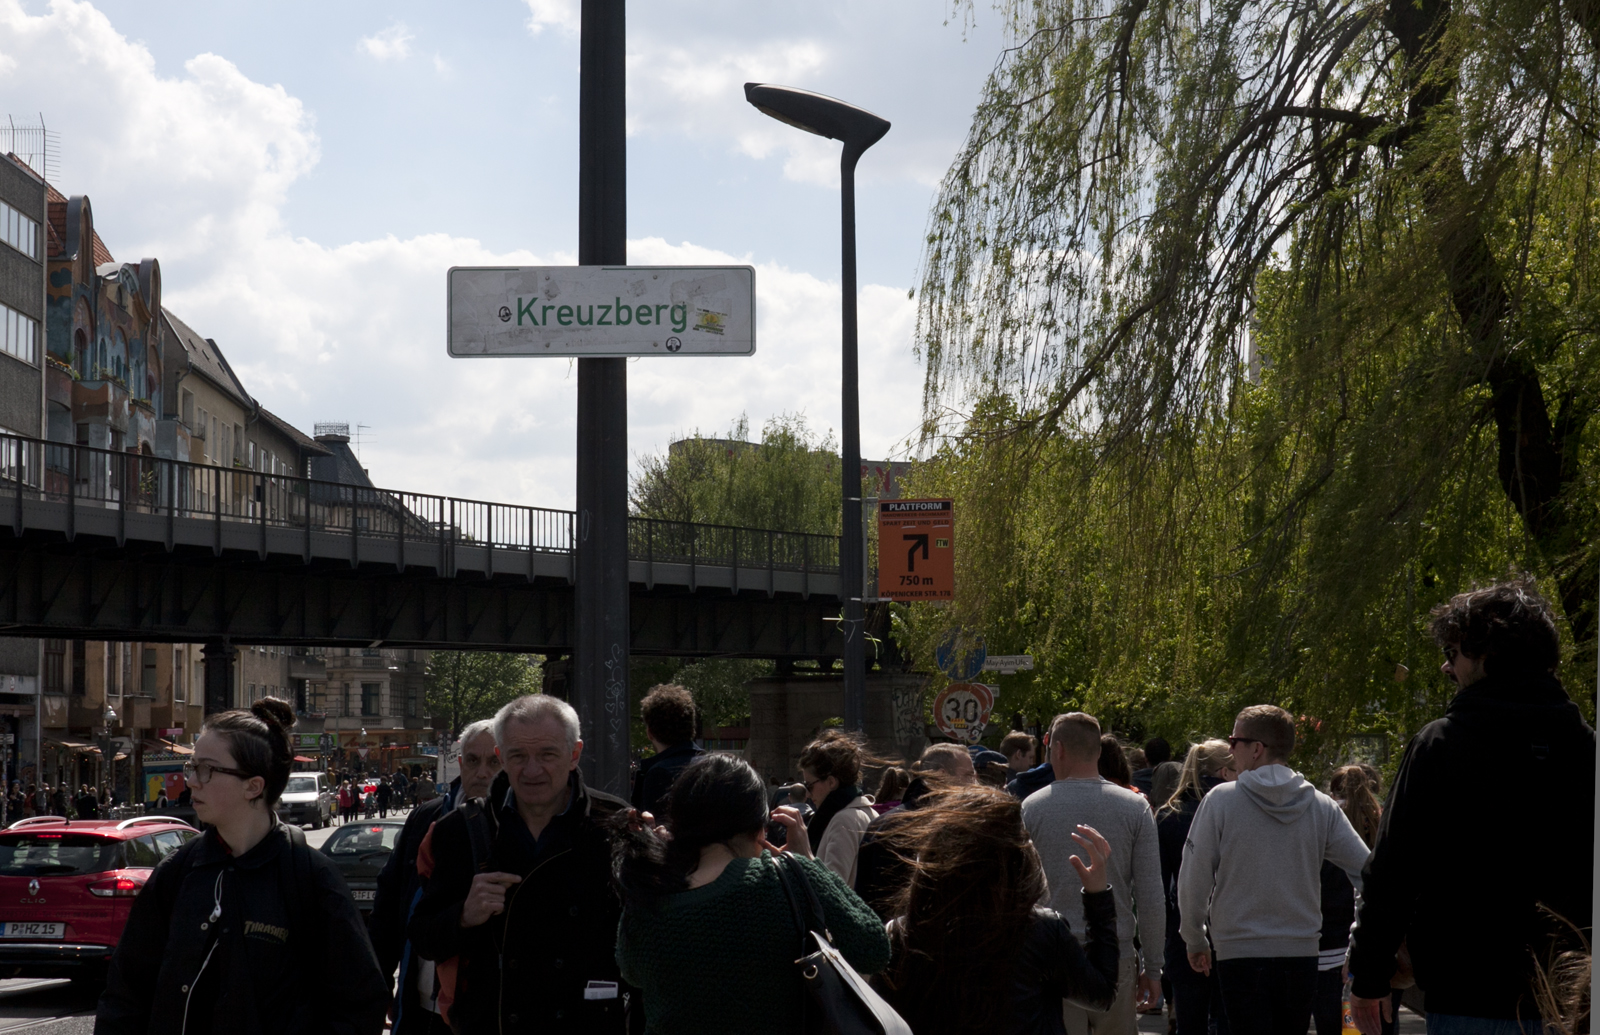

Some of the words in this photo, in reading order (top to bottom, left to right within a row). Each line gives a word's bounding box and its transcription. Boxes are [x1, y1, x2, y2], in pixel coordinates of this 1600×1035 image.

[517, 297, 687, 333] Kreuzberg
[889, 503, 942, 511] PLATTFORM
[936, 539, 949, 547] FTW
[899, 575, 920, 586] 750
[922, 577, 933, 585] m
[881, 590, 923, 598] KÖPENICKER
[946, 697, 978, 723] 30
[42, 924, 56, 934] 15
[243, 920, 289, 943] THRASHER
